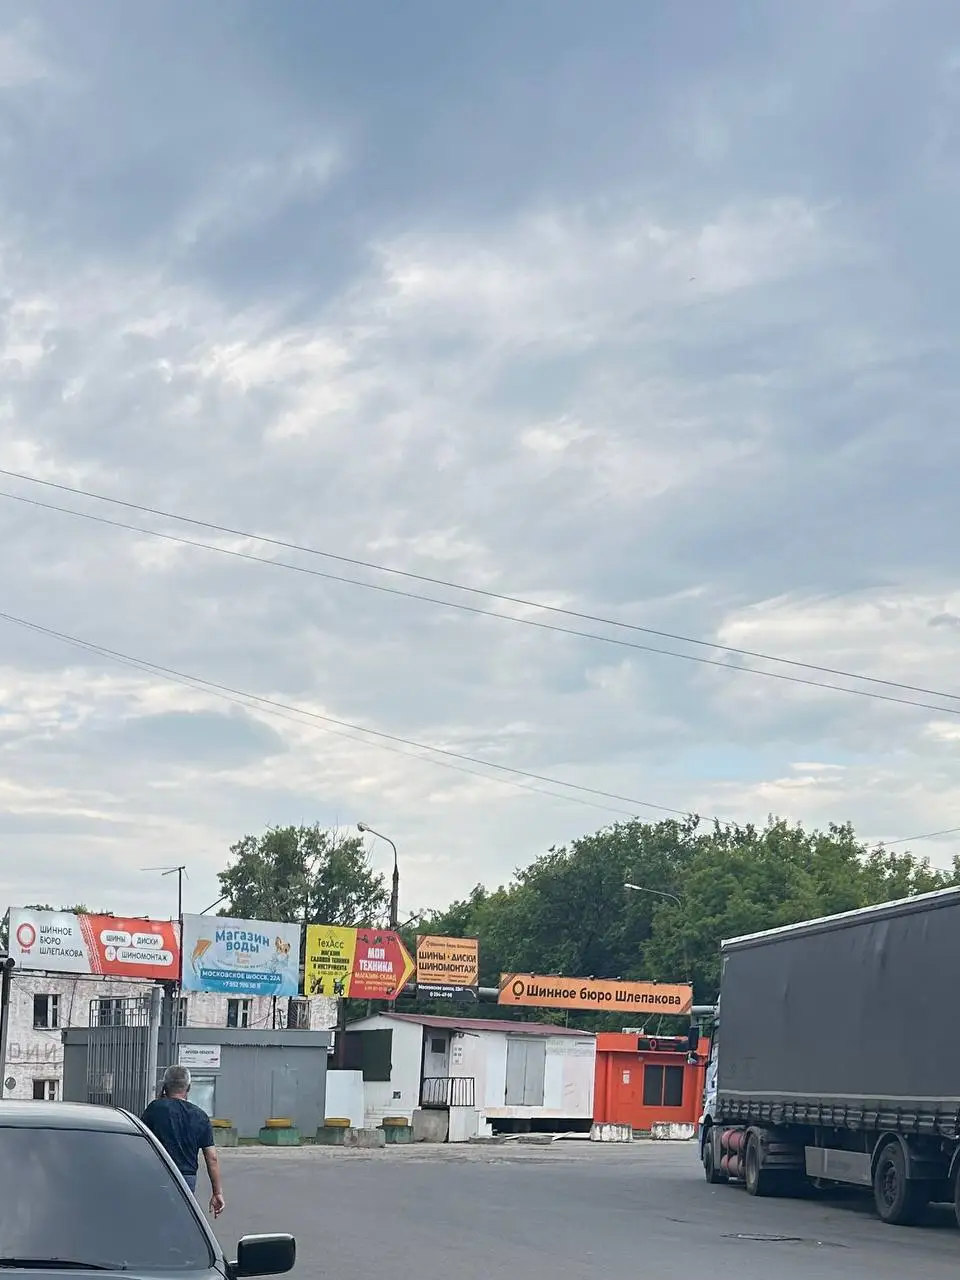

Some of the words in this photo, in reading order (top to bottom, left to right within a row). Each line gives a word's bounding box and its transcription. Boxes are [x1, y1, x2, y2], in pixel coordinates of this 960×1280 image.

[39, 926, 72, 936] ШИННОЕ
[39, 936, 61, 945] БЮРО
[136, 937, 159, 945] ДИСКИ
[215, 930, 270, 947] Магазин
[39, 948, 84, 958] ШЛЕПАКОВА
[121, 951, 168, 961] ШИНОМОНТАЖ
[367, 947, 385, 959] МОЯ
[419, 951, 445, 960] ШИНЫ
[451, 954, 476, 963] ДИСКИ
[359, 960, 393, 973] ТЕХНИКА
[419, 963, 476, 973] ШИНОМОНТАЖ
[202, 970, 245, 979] МОСКОВСКОЕ
[526, 984, 577, 999] Шинное
[580, 988, 612, 1003] бюро
[615, 990, 681, 1005] Шлепакова
